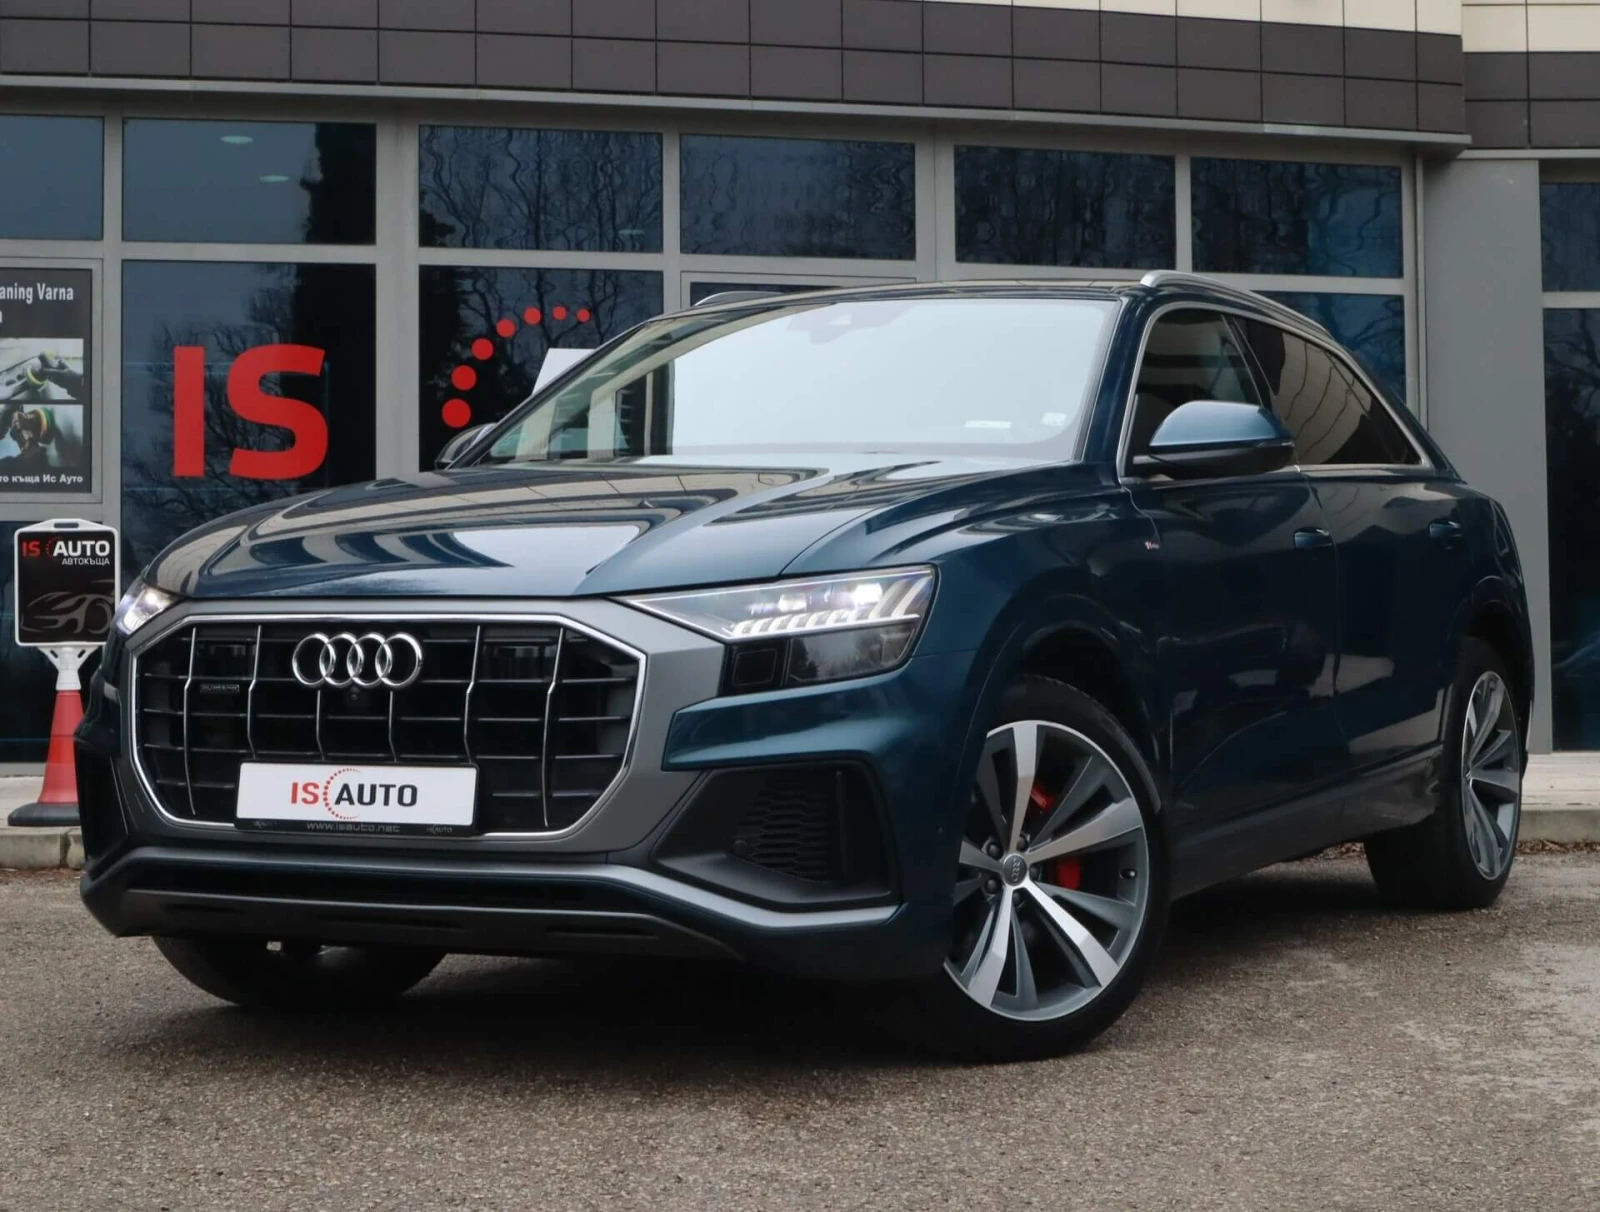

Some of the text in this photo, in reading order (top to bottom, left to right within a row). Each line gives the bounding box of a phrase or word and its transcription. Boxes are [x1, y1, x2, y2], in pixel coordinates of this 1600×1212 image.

[37, 282, 74, 301] Varna
[173, 343, 328, 480] IS
[12, 475, 40, 484] къща
[43, 473, 57, 483] Ис
[60, 473, 83, 485] Ауто
[22, 540, 110, 557] IS AUTO
[61, 557, 110, 567] АВТОКЪЩА
[290, 781, 418, 807] IS AUTO
